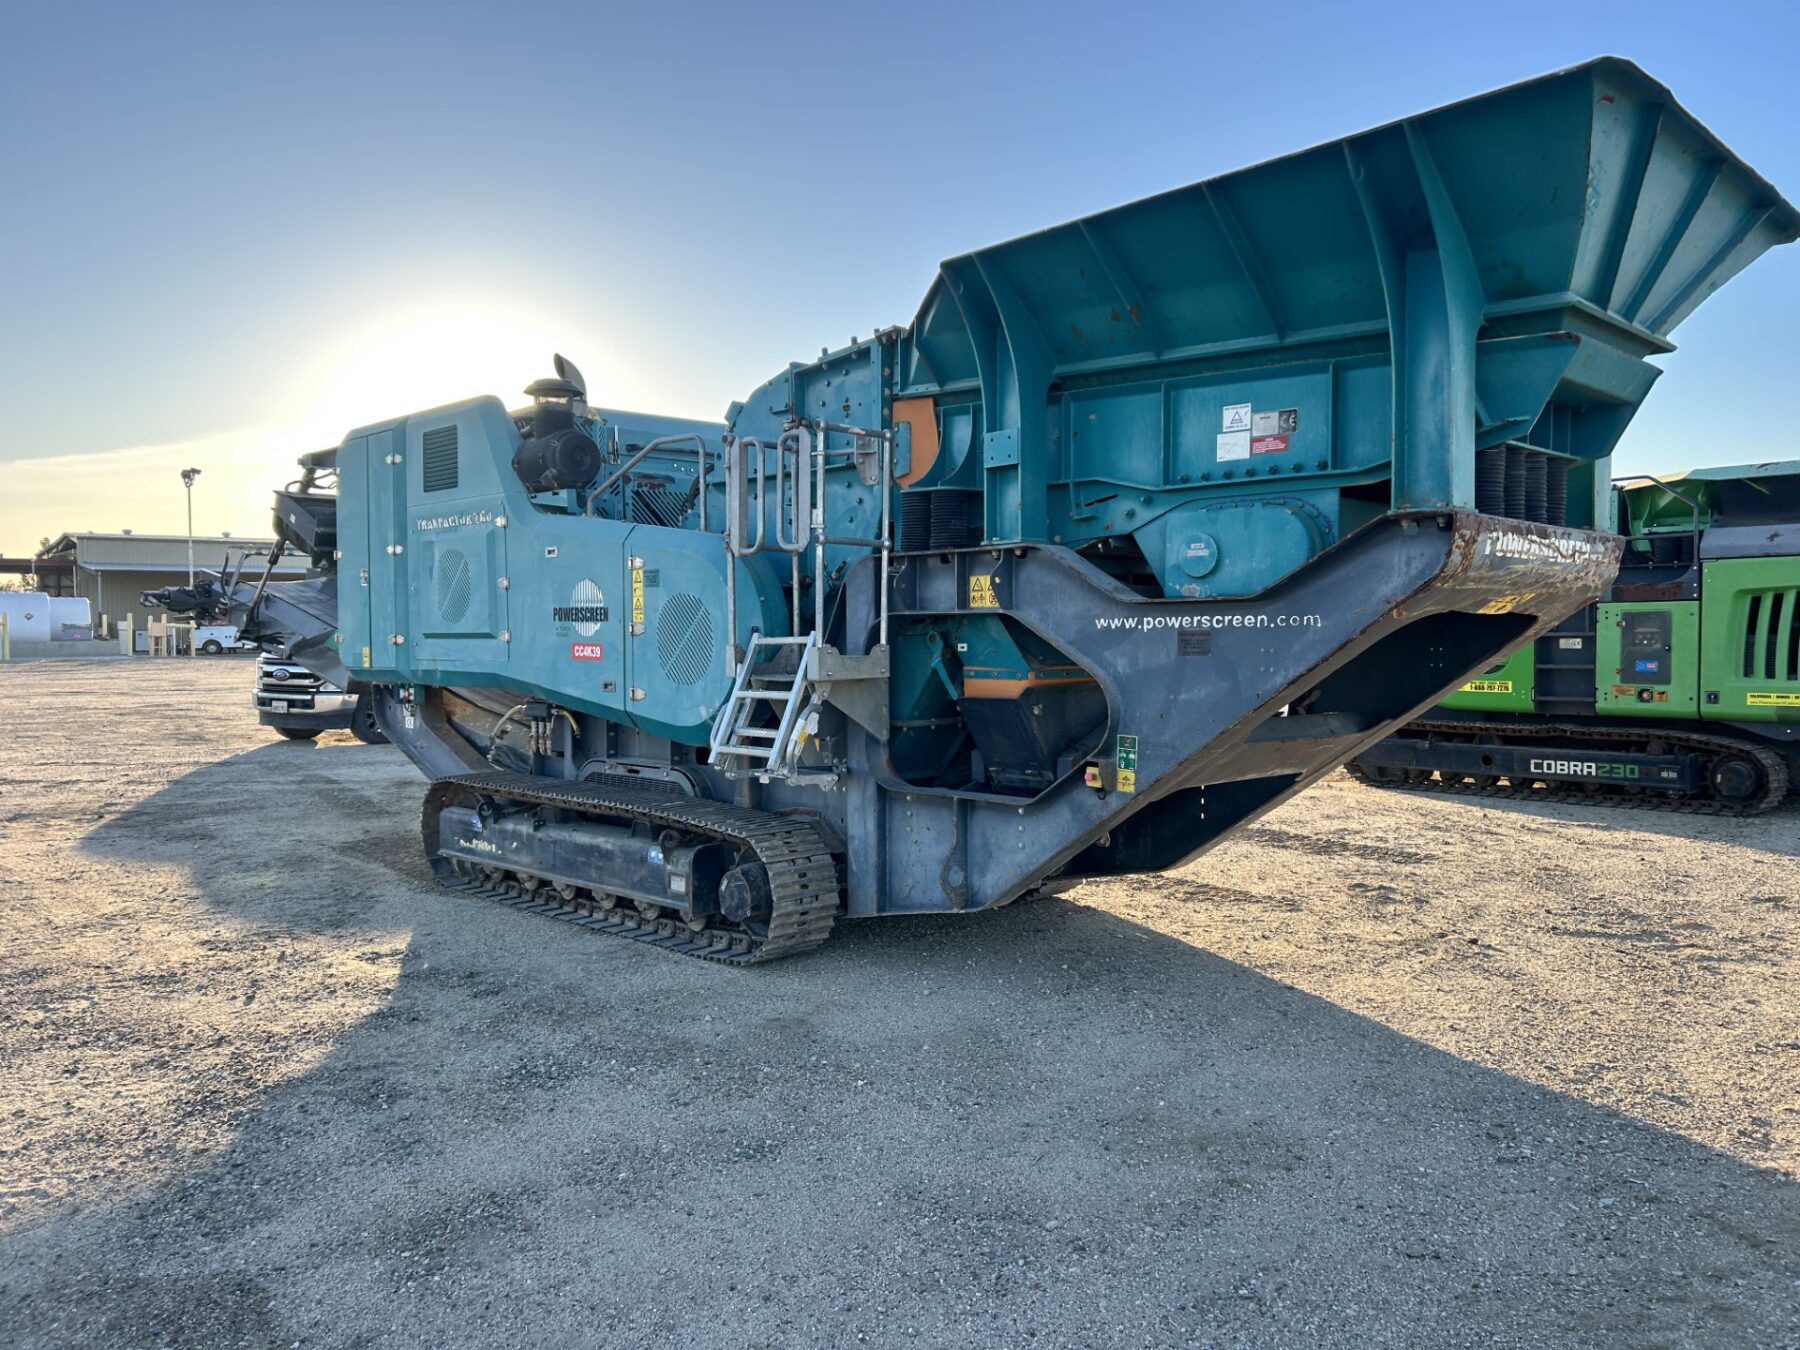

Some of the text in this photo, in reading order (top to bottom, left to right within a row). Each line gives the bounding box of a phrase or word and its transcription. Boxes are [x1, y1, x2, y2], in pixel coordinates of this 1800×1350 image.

[553, 606, 609, 623] POWERSCREEN
[1095, 614, 1322, 632] www.powerscreen.com
[574, 645, 601, 658] CC4K39
